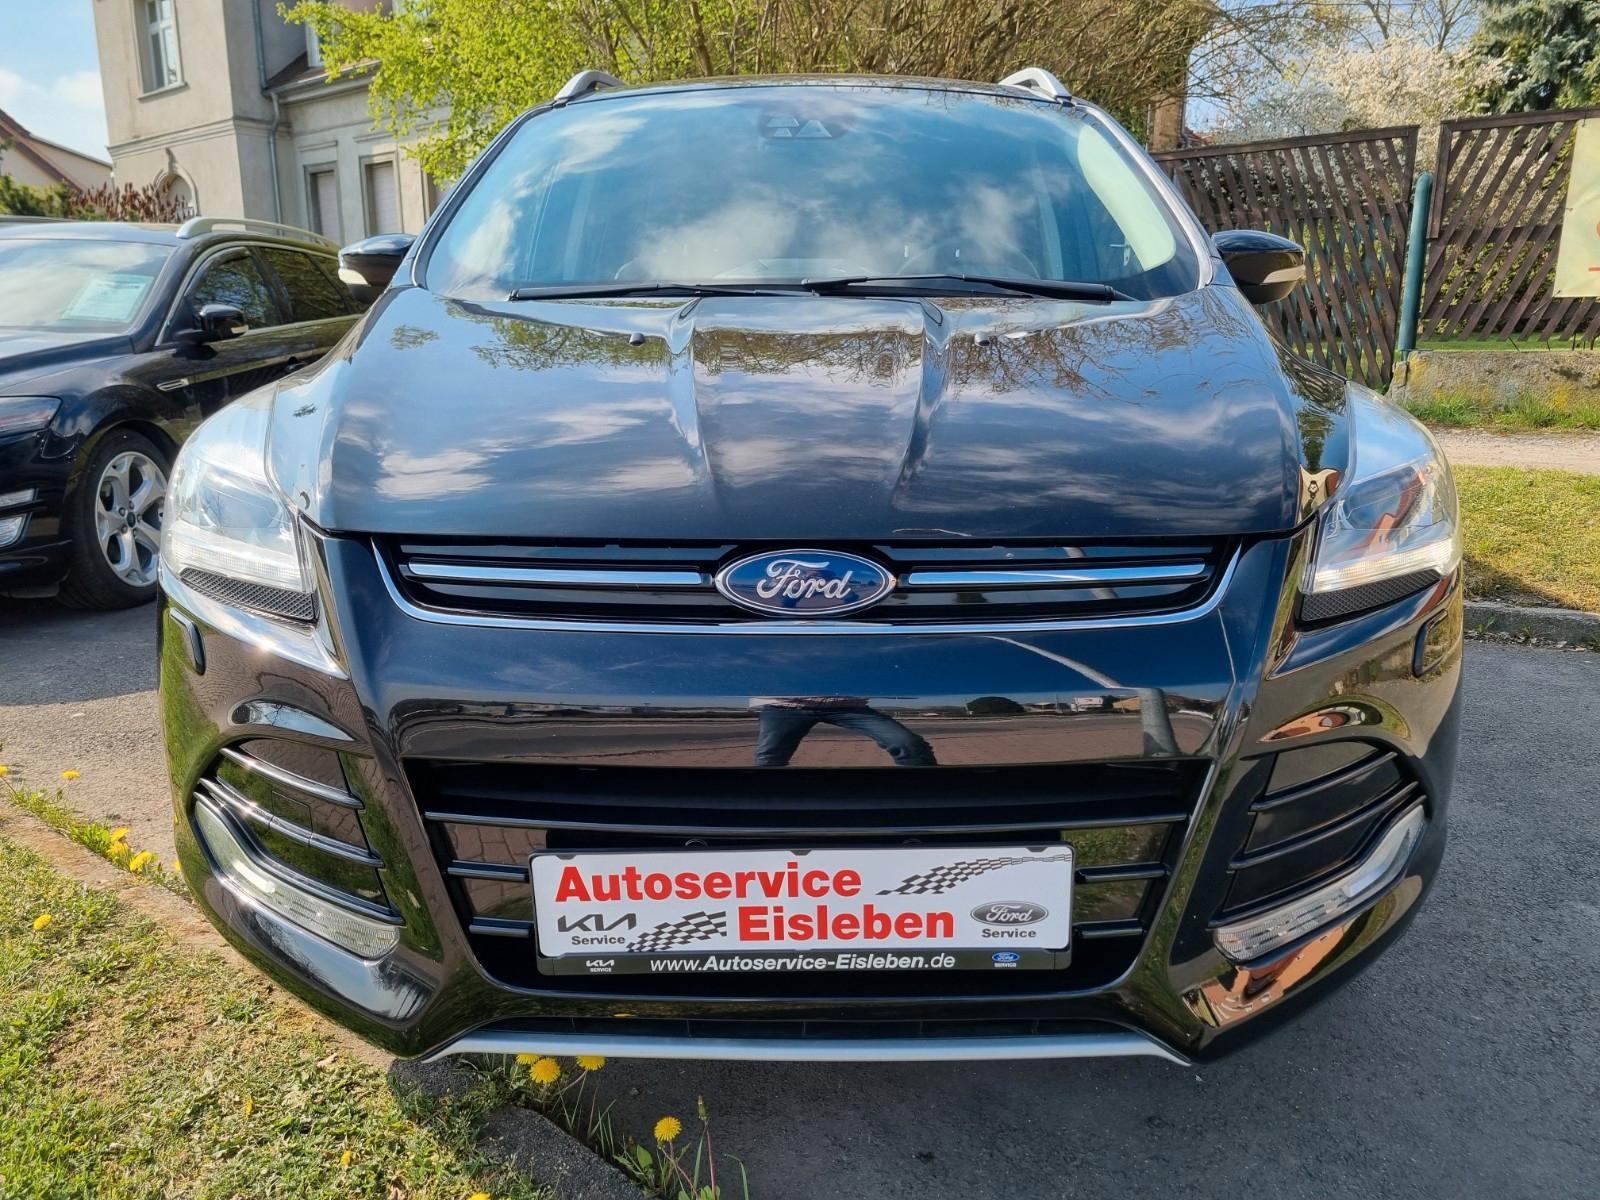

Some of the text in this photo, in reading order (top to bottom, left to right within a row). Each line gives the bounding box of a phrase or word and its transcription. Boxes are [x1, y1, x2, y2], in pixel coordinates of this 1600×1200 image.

[756, 558, 854, 600] Ford
[555, 861, 862, 903] Autoservice
[557, 912, 637, 933] KIA
[738, 904, 955, 941] Eisleben
[985, 903, 1034, 923] Ford
[571, 934, 626, 946] Service
[982, 928, 1037, 938] Service
[650, 952, 956, 972] www.Autoservice-Eisleben.de
